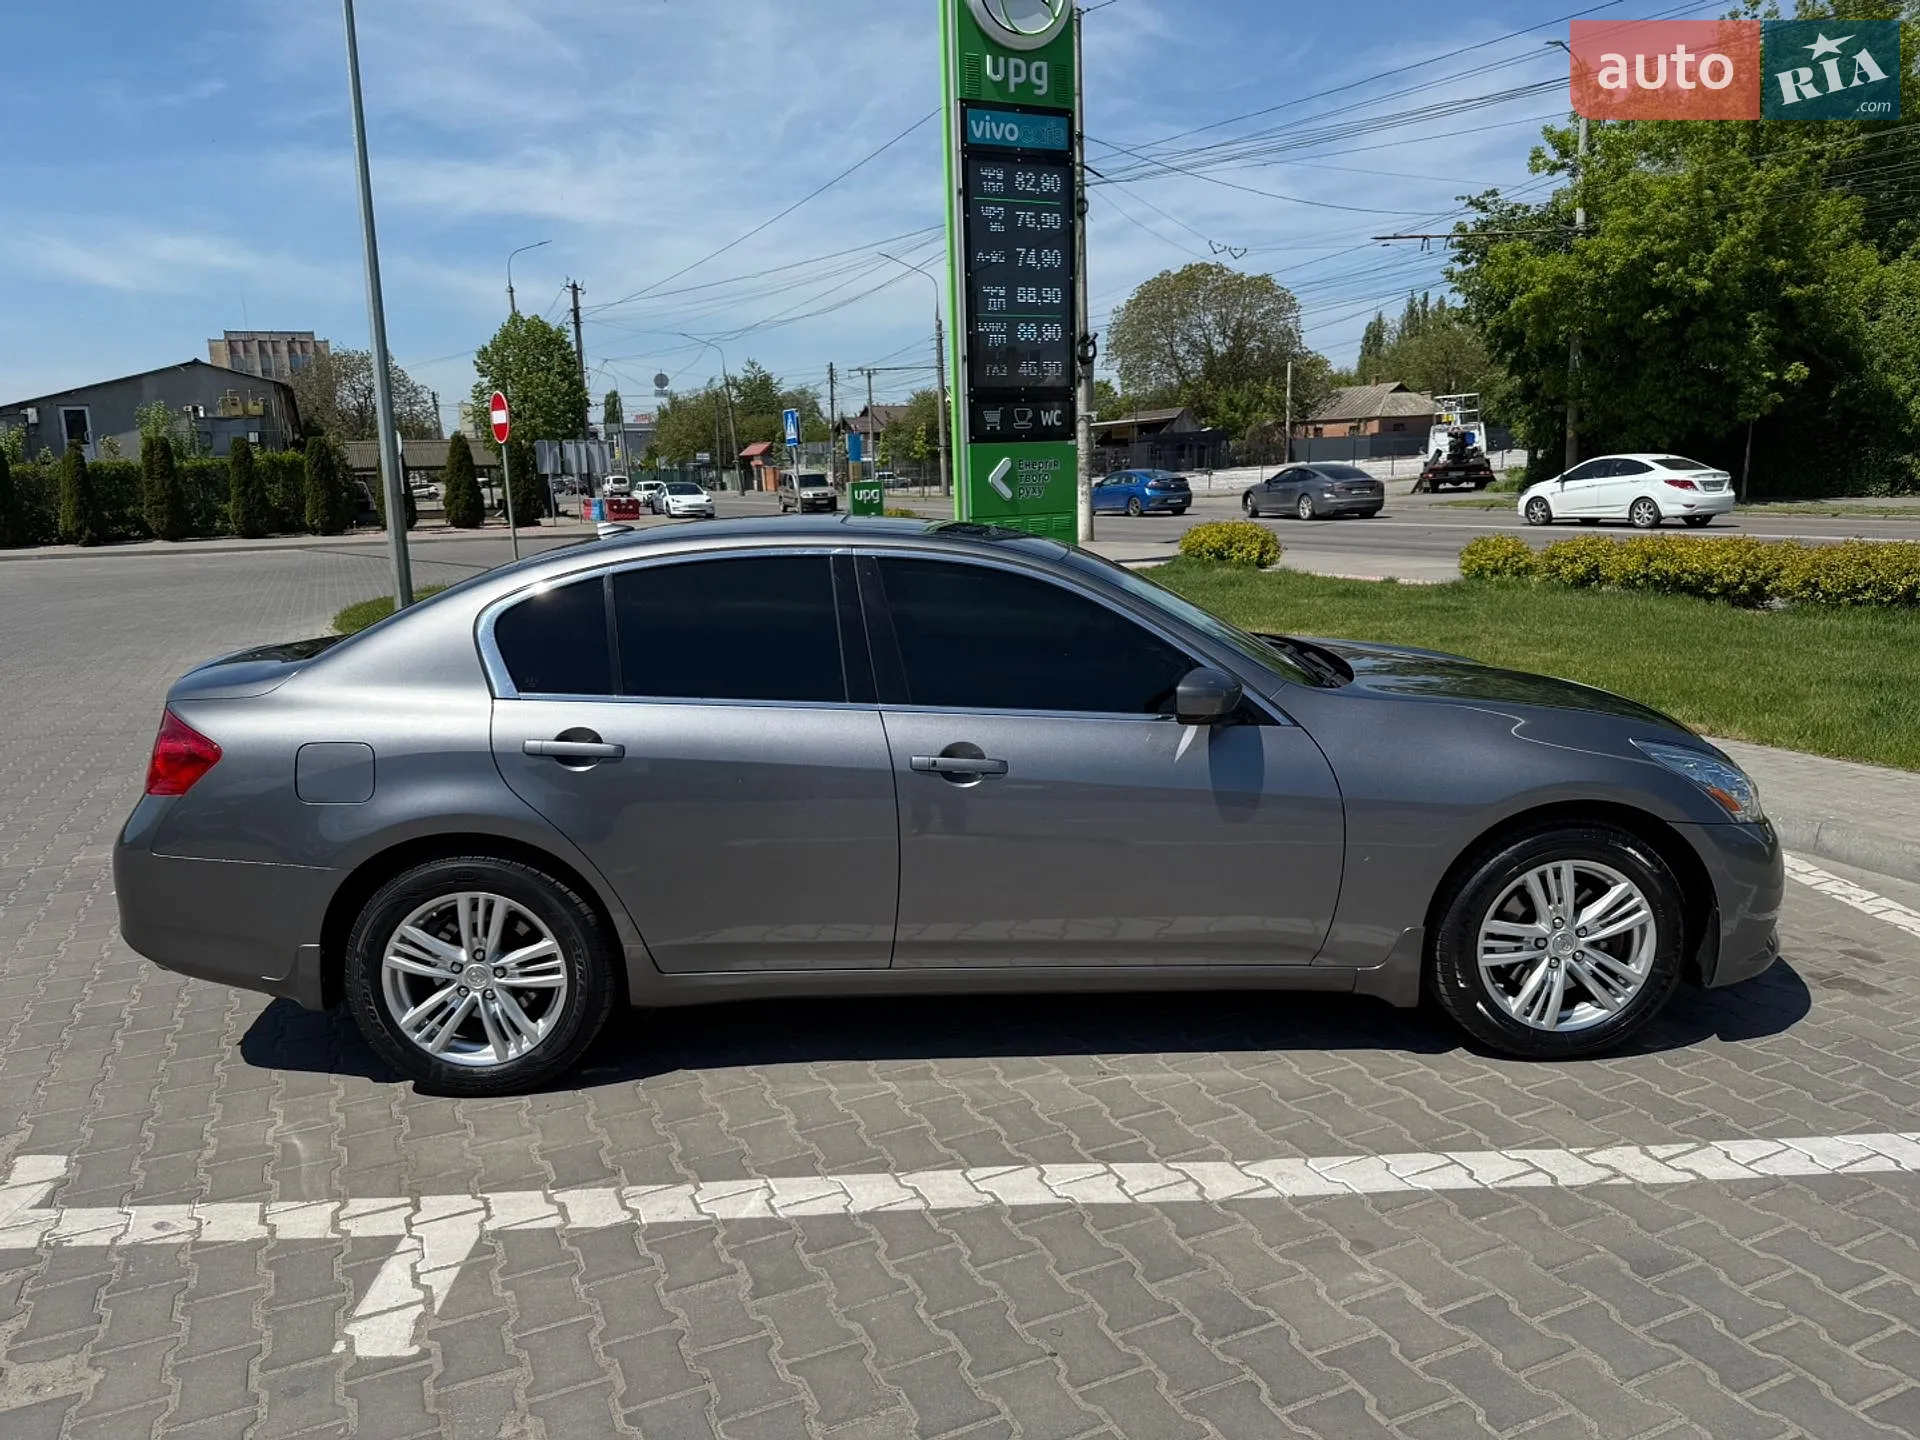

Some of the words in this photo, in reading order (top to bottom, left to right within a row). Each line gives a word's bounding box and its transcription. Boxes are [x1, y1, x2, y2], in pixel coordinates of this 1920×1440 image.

[986, 54, 1049, 96] upg
[971, 115, 1019, 141] vivo
[1041, 410, 1062, 427] WC
[854, 489, 880, 504] upg
